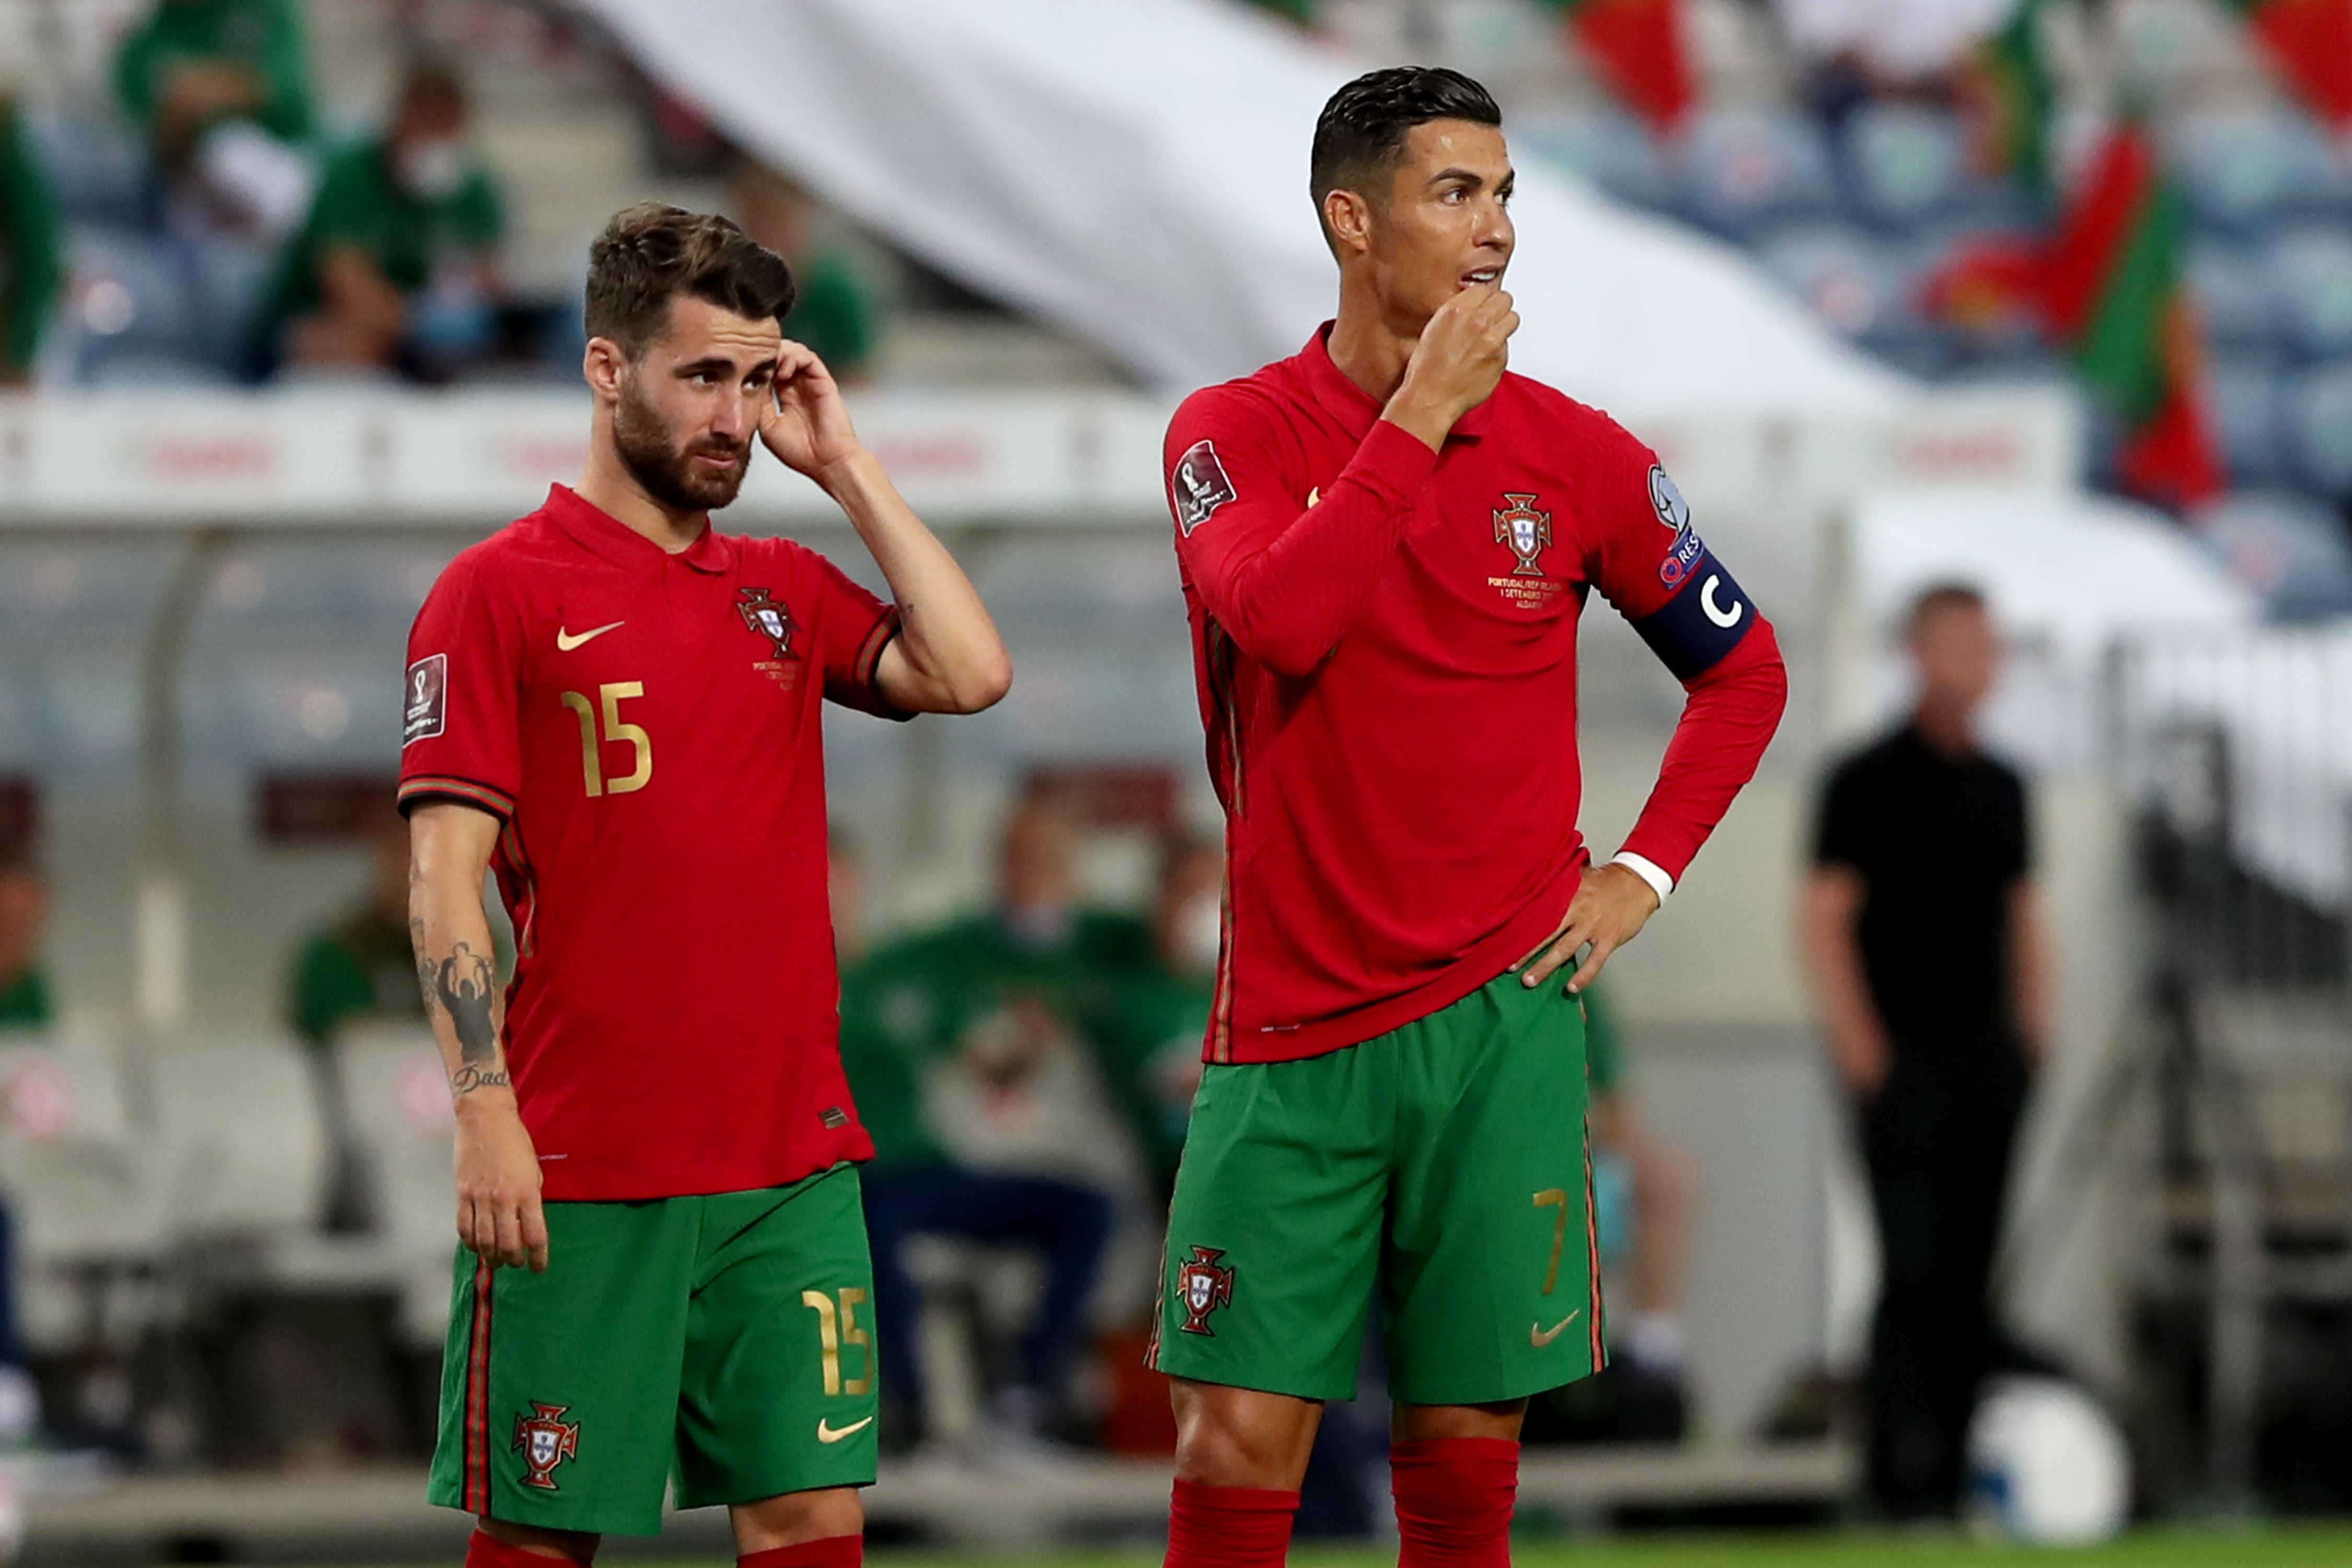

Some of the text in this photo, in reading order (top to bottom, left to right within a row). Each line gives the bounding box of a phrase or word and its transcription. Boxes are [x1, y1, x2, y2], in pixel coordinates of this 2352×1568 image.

[1678, 529, 1699, 564] RES
[1701, 574, 1742, 628] C
[560, 681, 653, 797] 15
[453, 1063, 508, 1093] Dad
[1532, 1188, 1567, 1295] 7
[801, 1288, 872, 1396] 15
